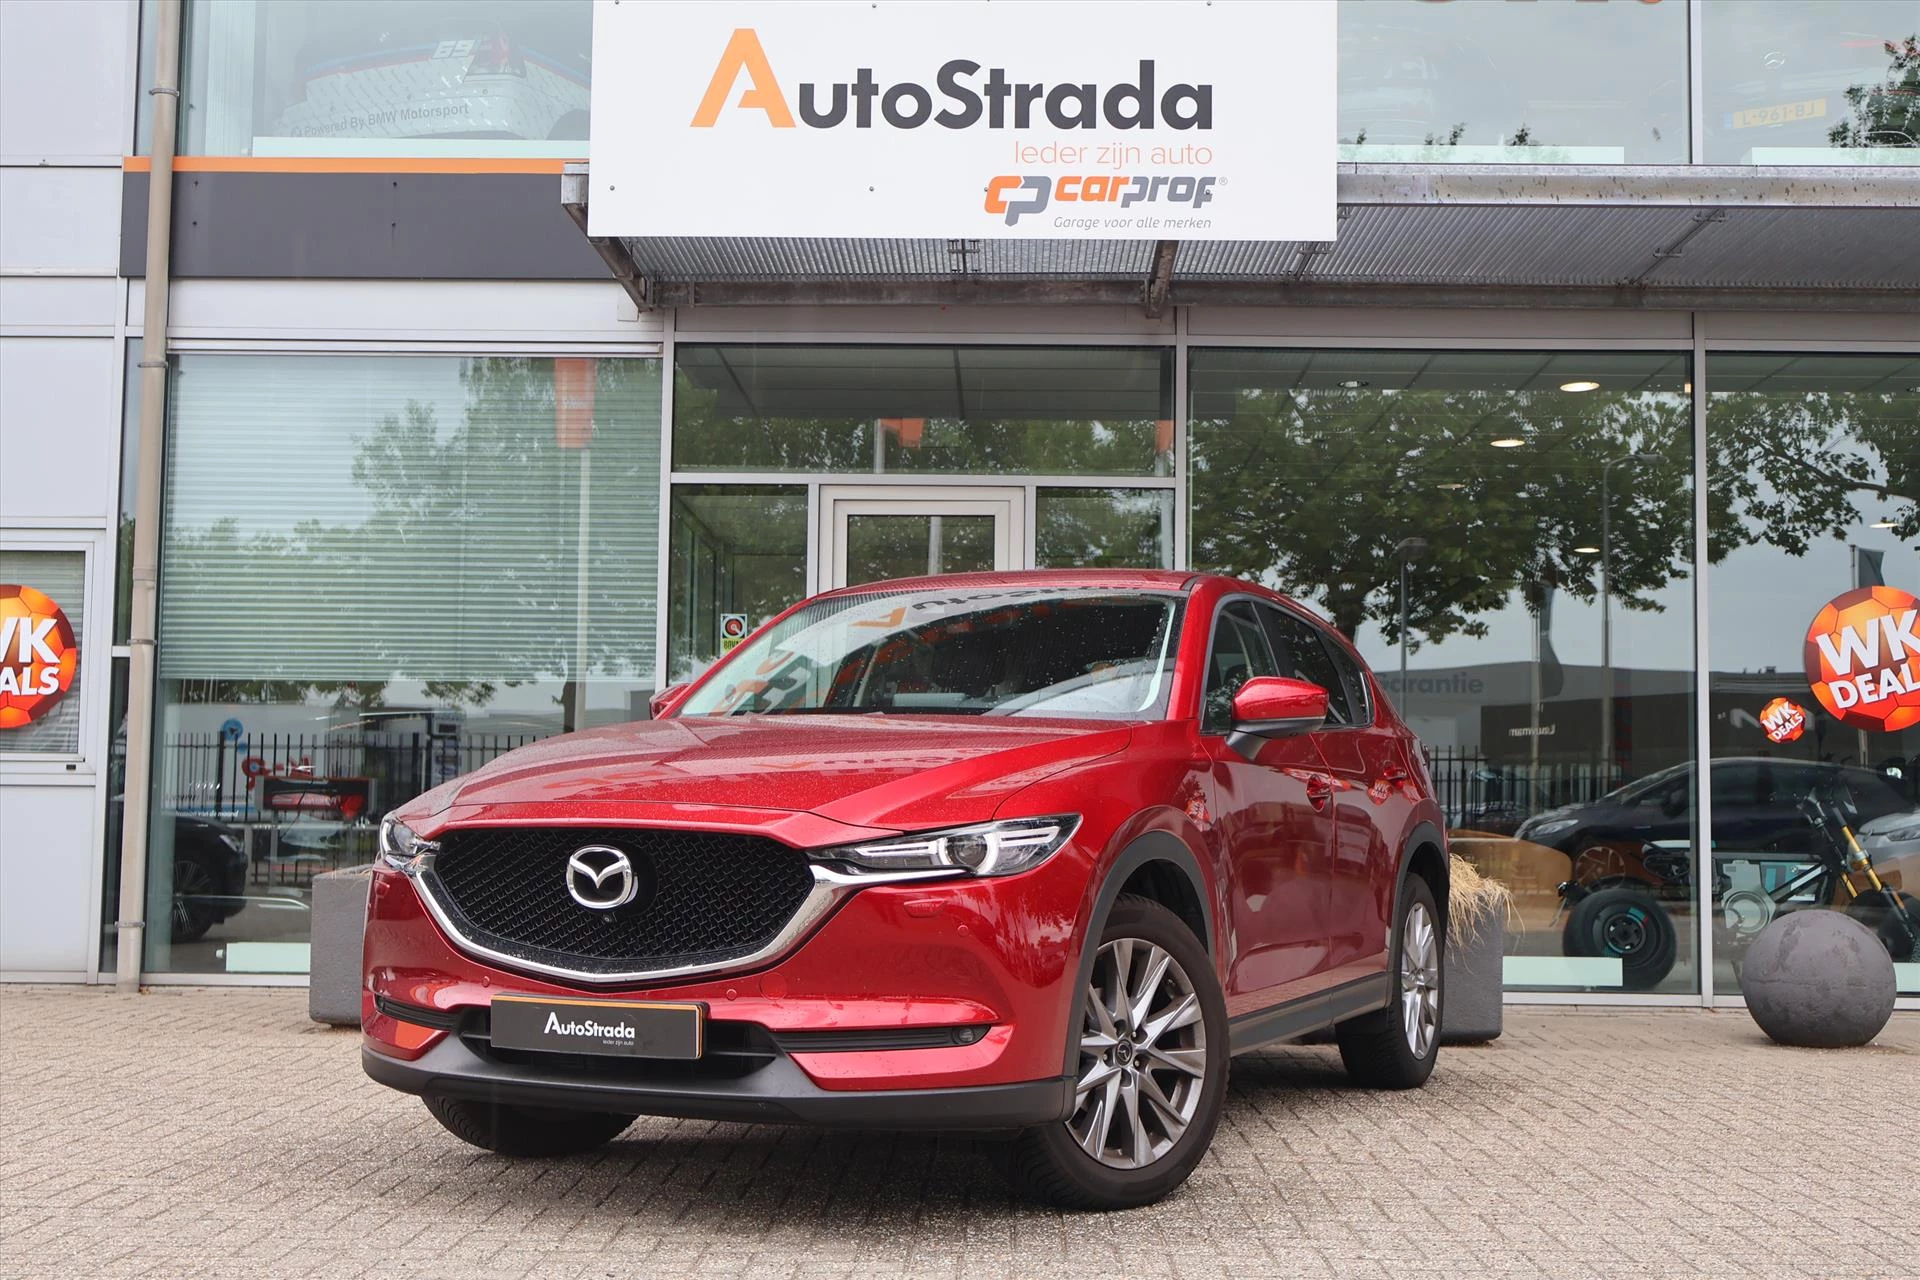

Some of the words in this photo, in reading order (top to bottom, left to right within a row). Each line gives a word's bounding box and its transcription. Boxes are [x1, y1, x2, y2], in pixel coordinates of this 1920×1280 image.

[690, 28, 1213, 131] AutoStrada
[305, 118, 347, 137] Powered
[351, 116, 365, 129] By
[368, 111, 398, 126] BMW
[400, 103, 470, 120] Motorsport
[1015, 141, 1088, 164] Ieder
[1096, 142, 1140, 170] zijn
[1150, 143, 1213, 165] auto
[1054, 176, 1217, 209] carprof
[1054, 216, 1100, 231] Garage
[1104, 218, 1134, 228] voor
[1136, 216, 1161, 228] alle
[1163, 217, 1212, 229] merken
[1815, 609, 1920, 676] WK
[0, 666, 60, 696] ALS
[1828, 662, 1920, 709] DEAL
[1761, 701, 1799, 731] WK
[1771, 712, 1804, 741] DEALS
[543, 1011, 636, 1039] AutoStrada
